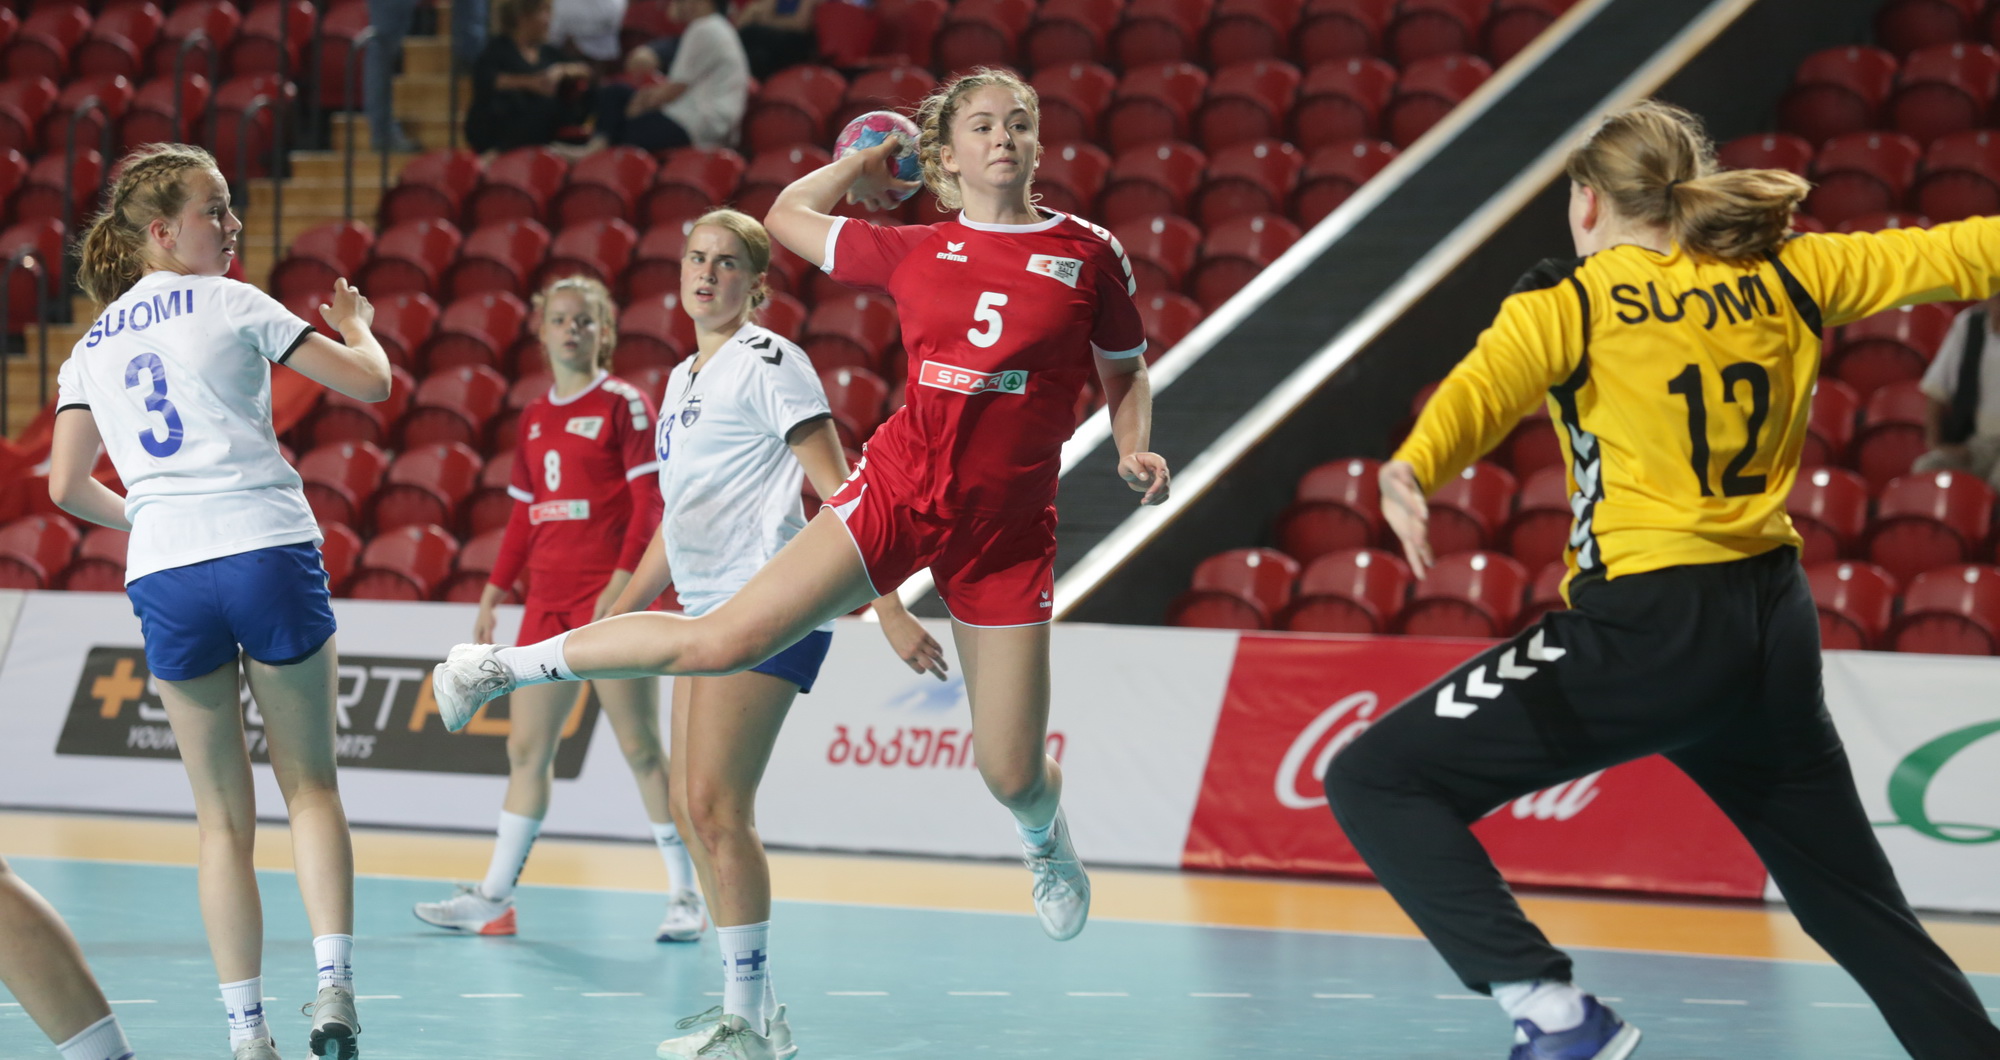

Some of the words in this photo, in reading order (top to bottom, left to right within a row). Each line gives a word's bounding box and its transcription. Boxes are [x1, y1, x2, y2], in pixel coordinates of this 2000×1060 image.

[936, 252, 968, 263] erima
[86, 289, 194, 348] SUOMI
[967, 291, 1008, 348] 5
[1610, 273, 1777, 331] SUOMI
[124, 352, 184, 458] 3
[936, 369, 1000, 390] SPAR
[658, 413, 676, 461] 13
[1667, 361, 1770, 498] 12
[544, 449, 561, 492] 8
